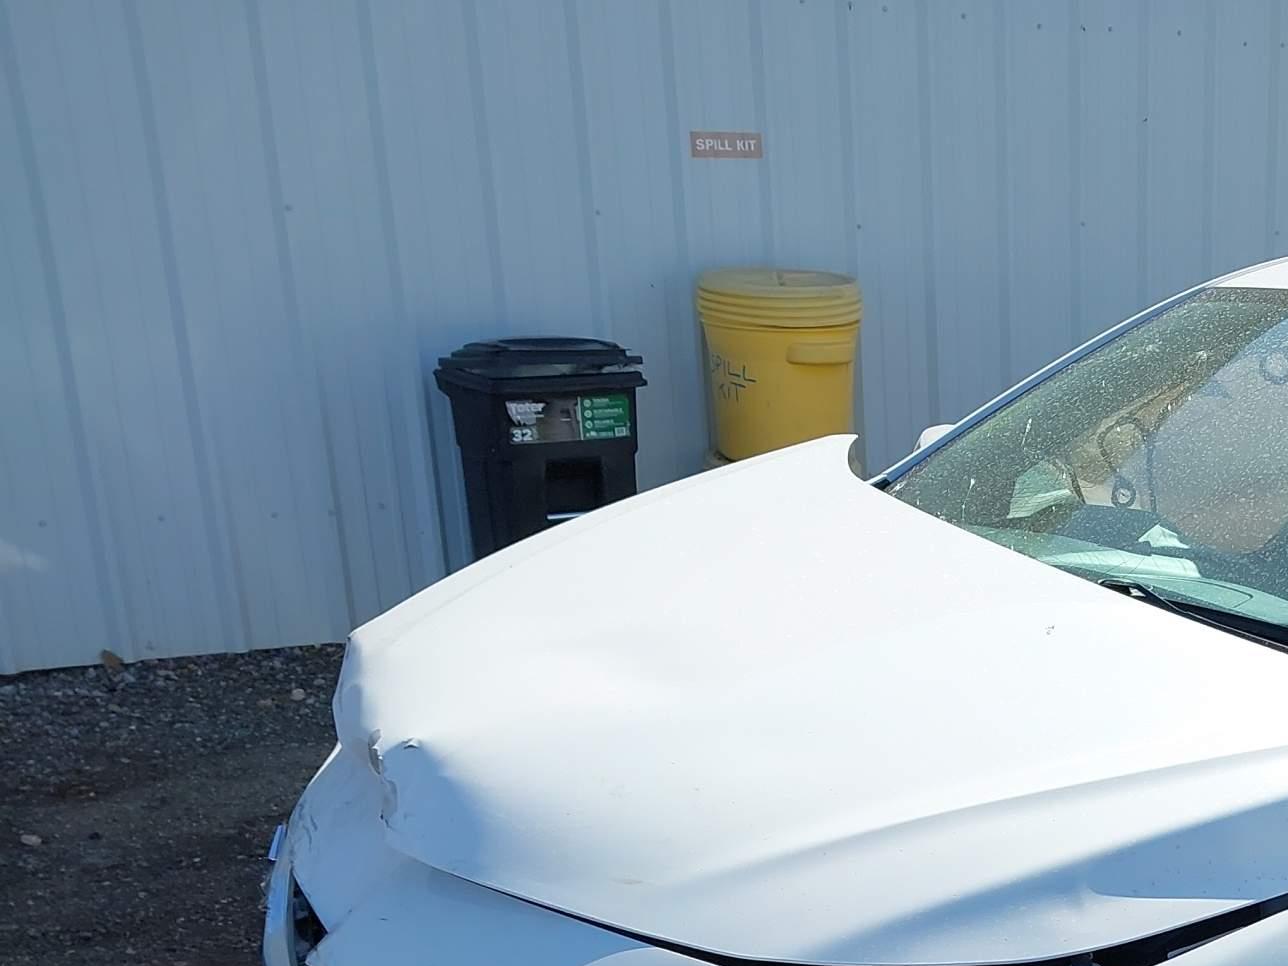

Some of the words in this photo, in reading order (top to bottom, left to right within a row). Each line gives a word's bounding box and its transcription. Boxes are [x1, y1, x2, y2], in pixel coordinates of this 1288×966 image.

[695, 138, 733, 151] SPILL
[736, 139, 757, 151] KIT
[511, 428, 533, 442] 32
